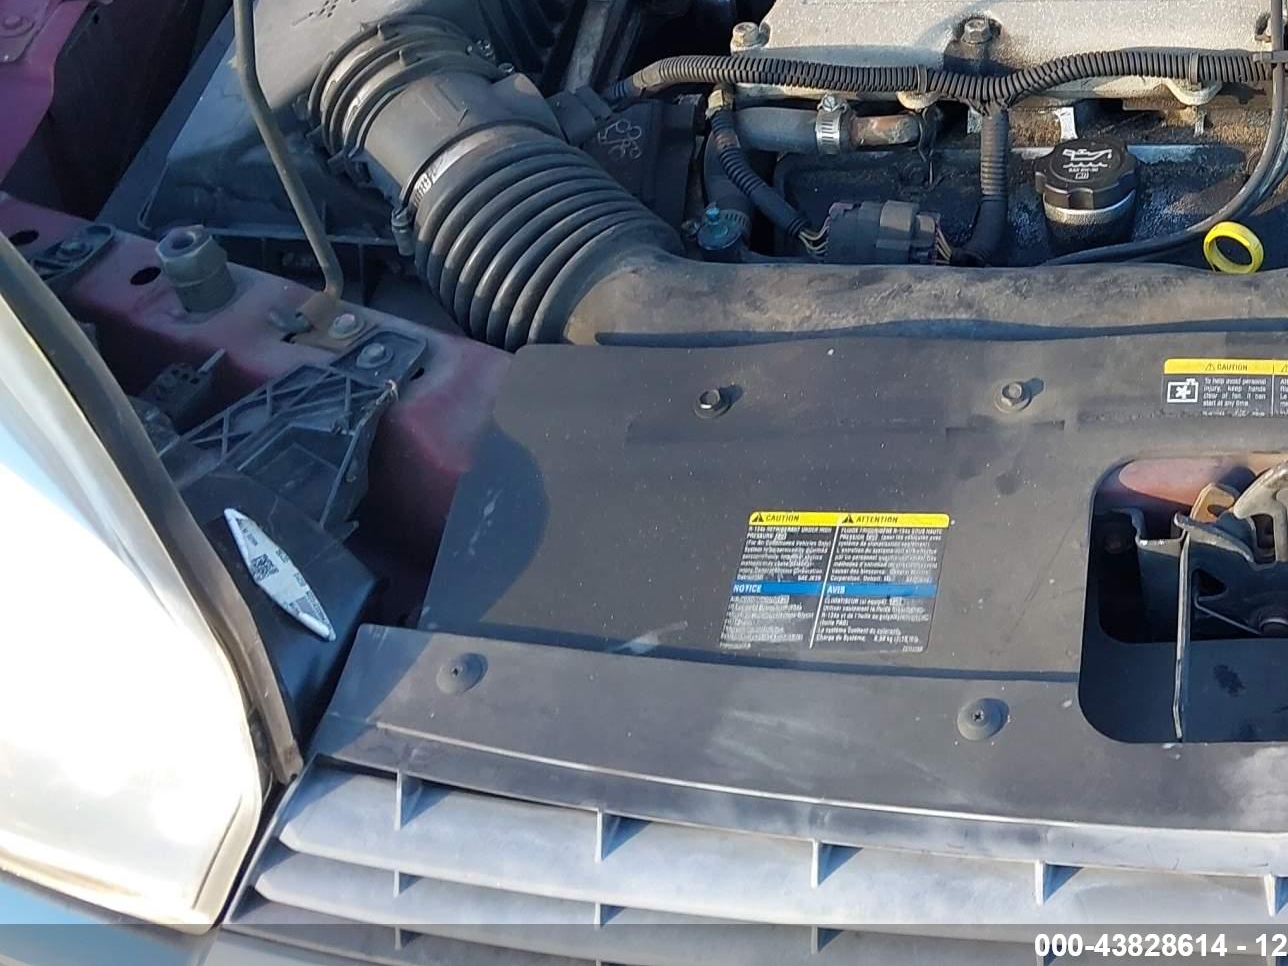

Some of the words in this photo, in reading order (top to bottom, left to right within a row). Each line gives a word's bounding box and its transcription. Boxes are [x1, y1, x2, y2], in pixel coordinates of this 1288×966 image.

[1212, 378, 1225, 386] help
[766, 514, 800, 522] CAUTION
[733, 584, 762, 593] NOTICE
[827, 585, 845, 594] AVIS
